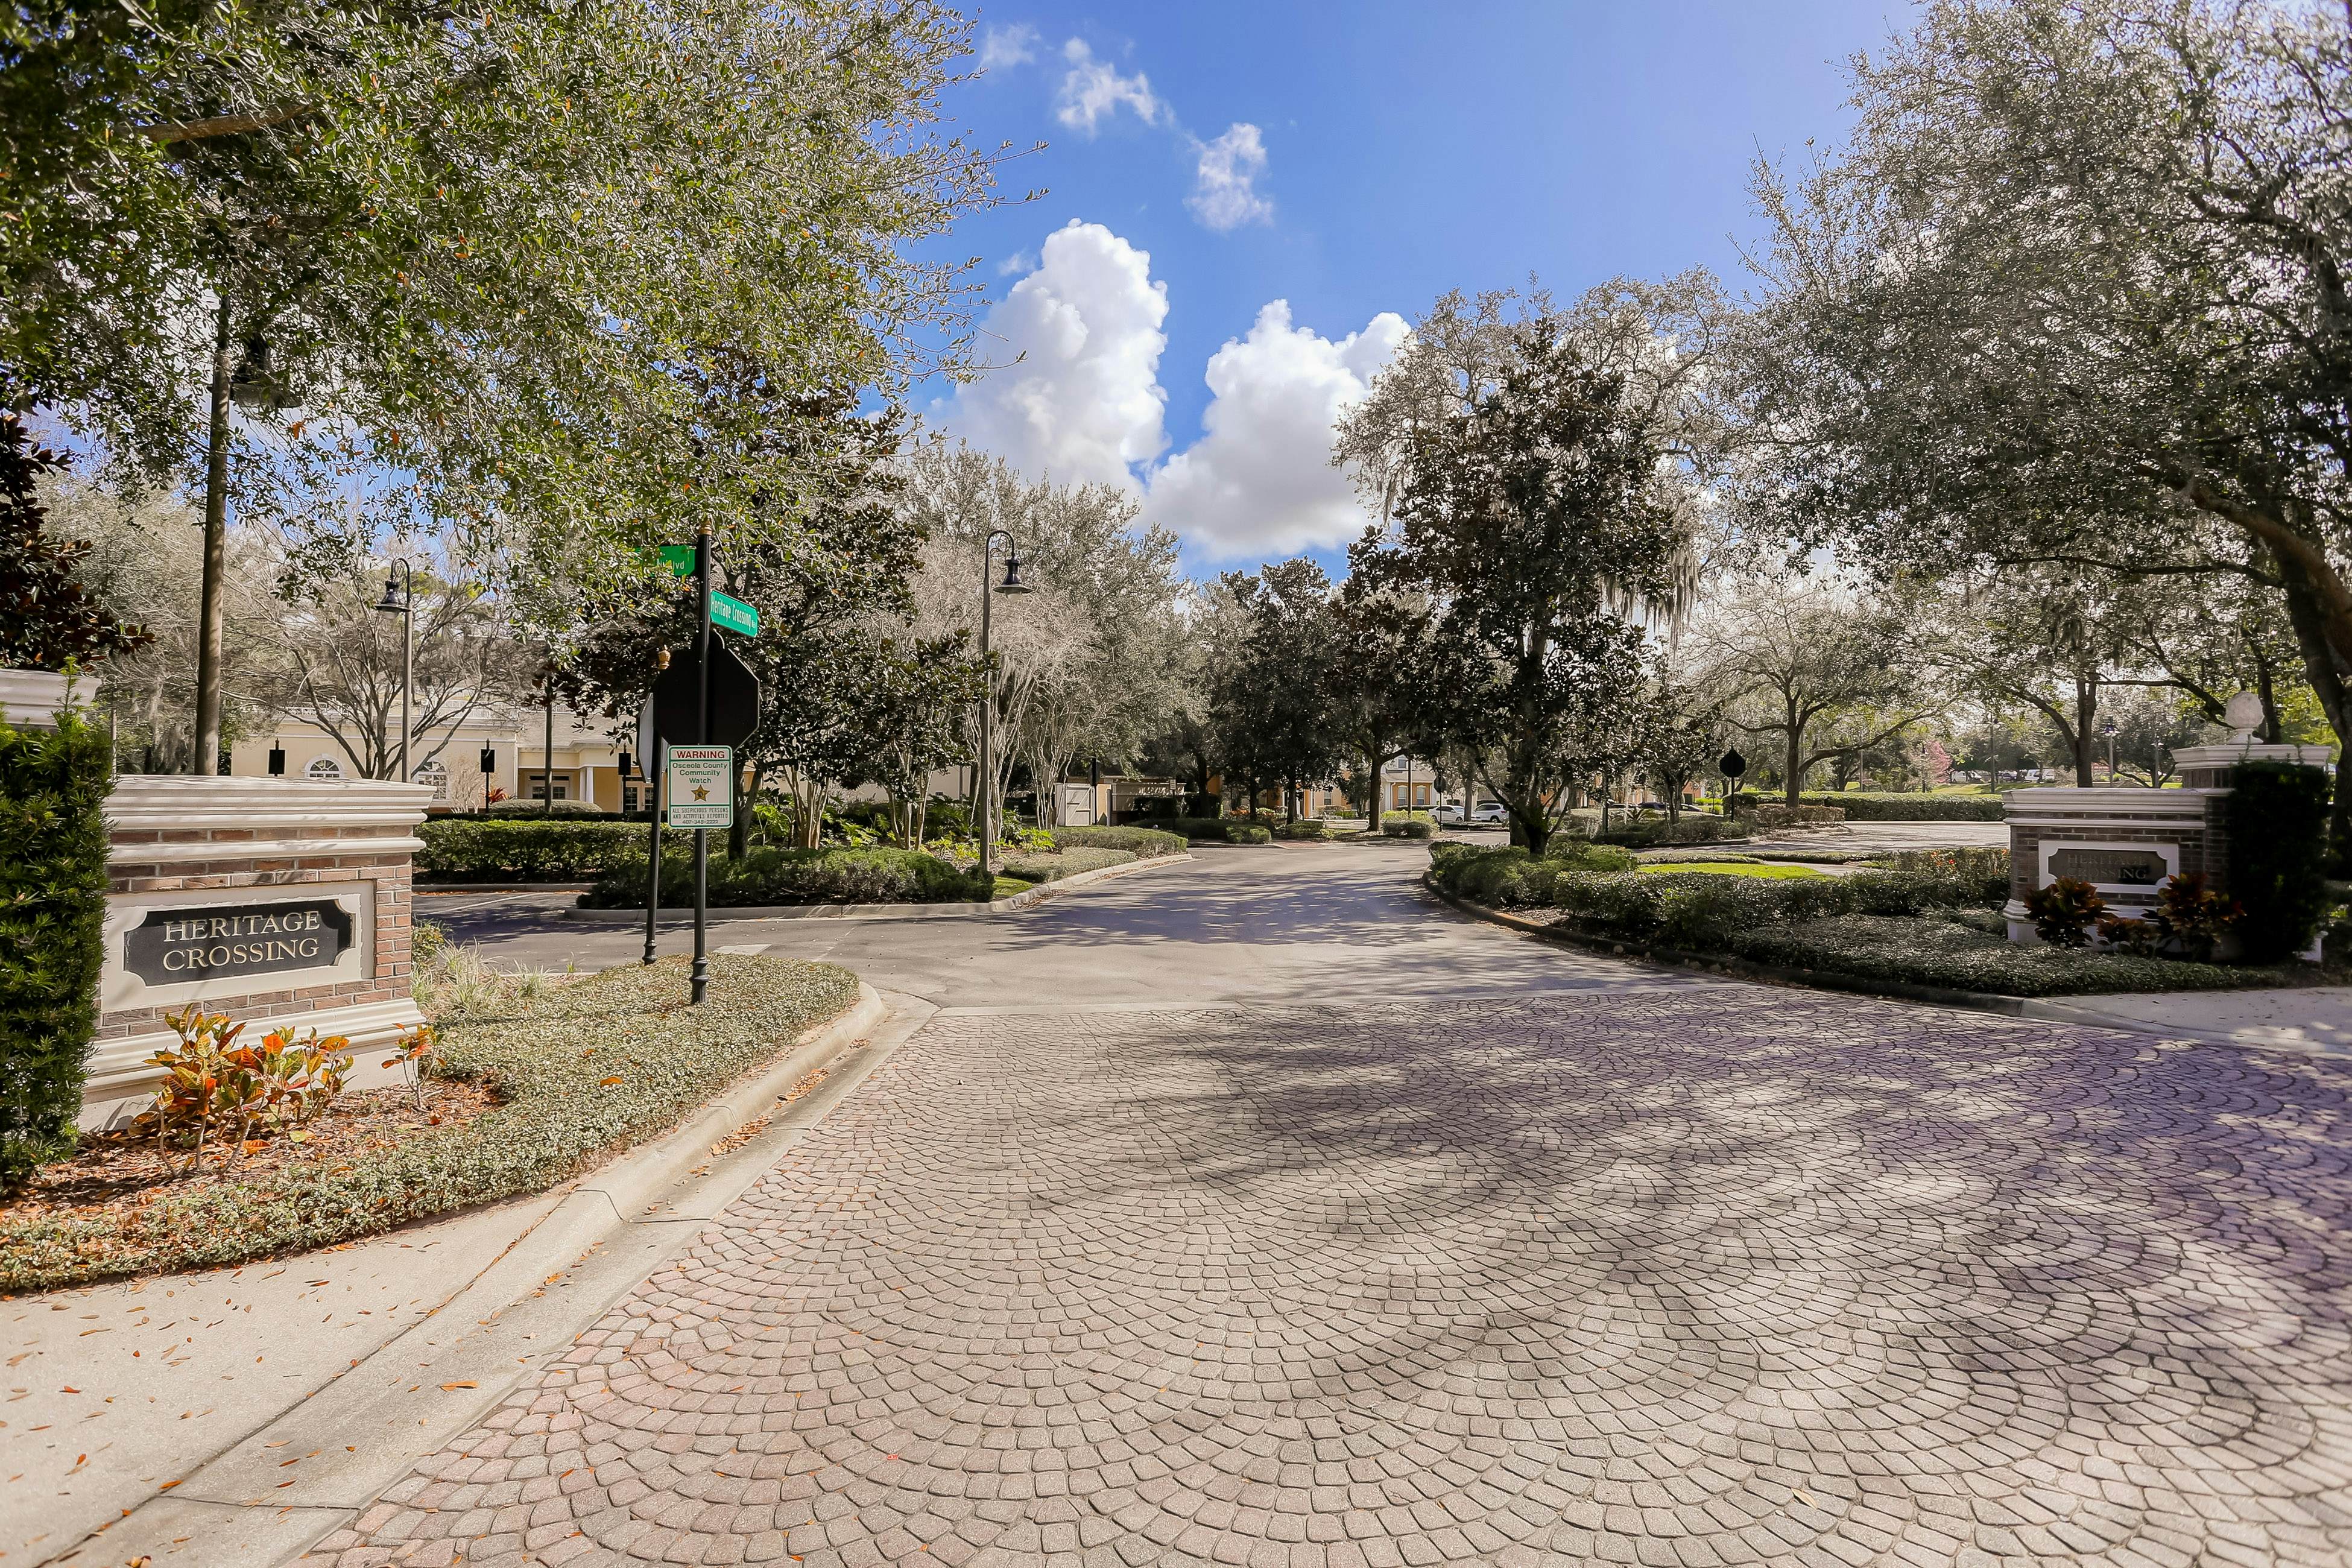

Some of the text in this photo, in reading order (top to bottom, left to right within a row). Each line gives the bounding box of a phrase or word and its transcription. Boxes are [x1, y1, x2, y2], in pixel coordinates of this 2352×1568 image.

[711, 594, 731, 623] Heritage
[732, 604, 751, 631] Crossing
[2066, 853, 2148, 865] HERITAGE
[2066, 867, 2146, 879] CROSSING
[163, 910, 320, 943] HERITAGE
[163, 938, 320, 972] CROSSING
